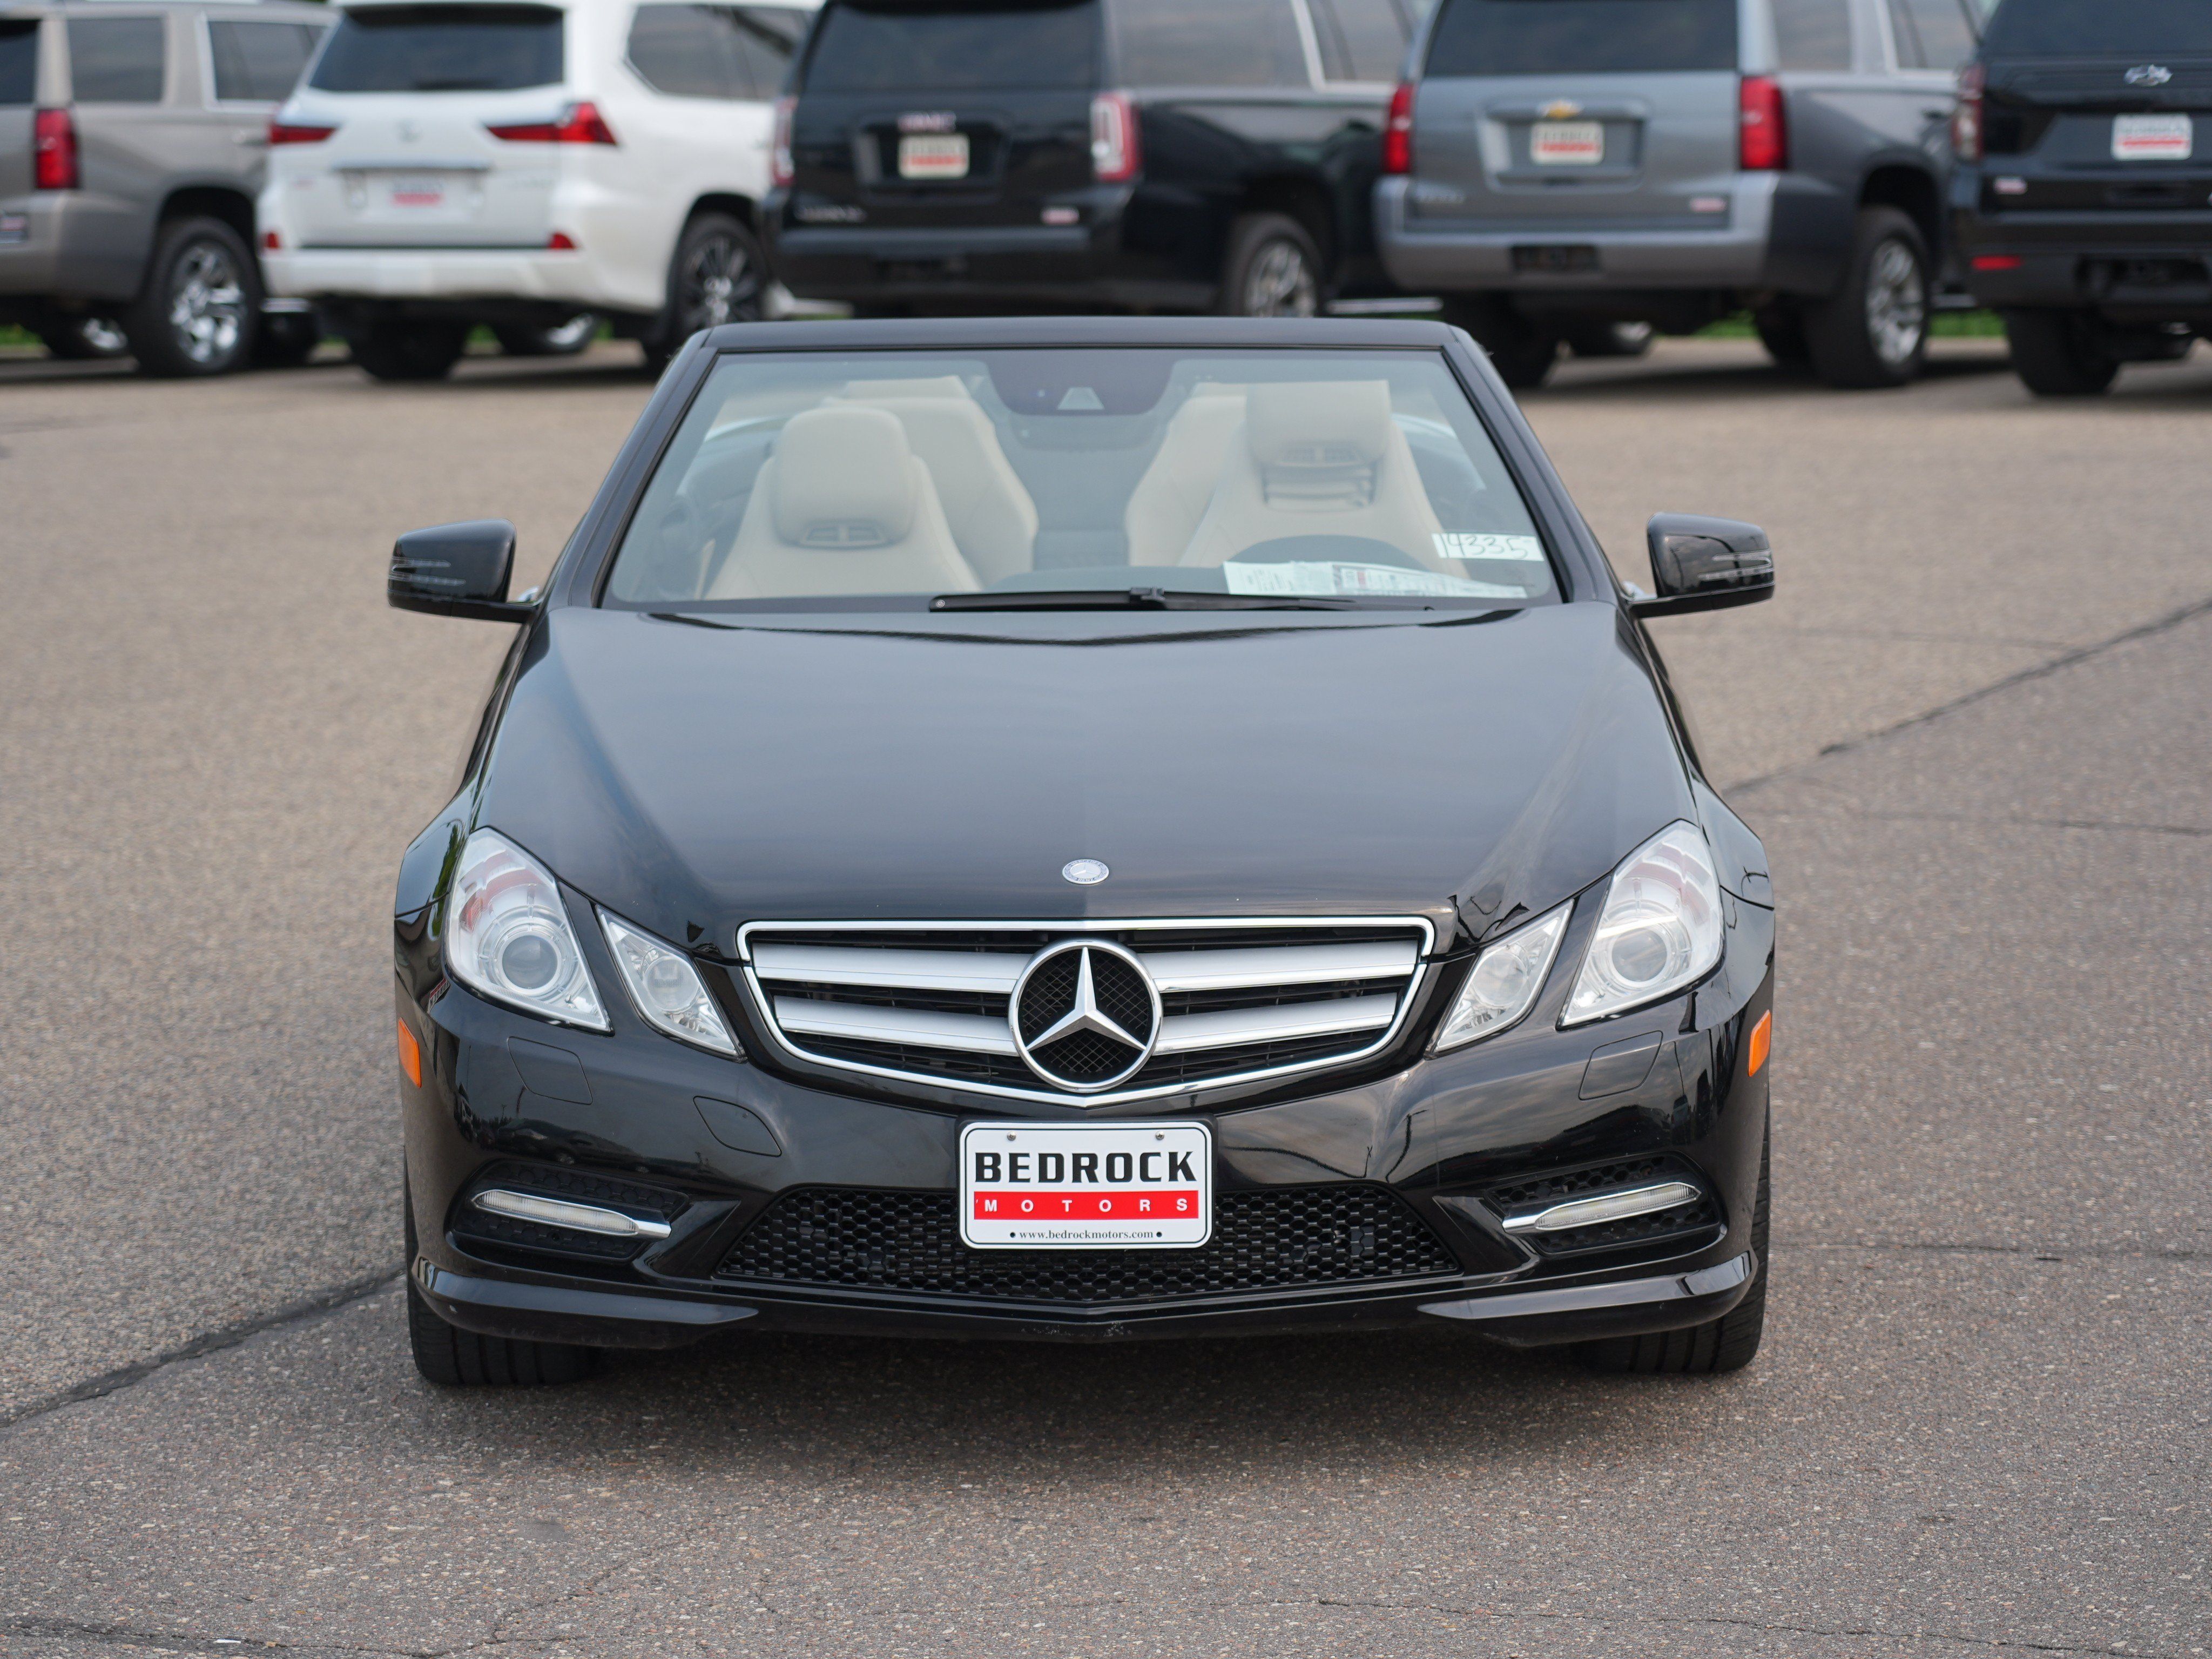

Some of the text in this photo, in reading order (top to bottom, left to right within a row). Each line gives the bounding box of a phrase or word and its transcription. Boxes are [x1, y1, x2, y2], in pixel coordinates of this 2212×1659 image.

[1439, 532, 1528, 559] 14335
[975, 1151, 1197, 1183] BEDROCK
[984, 1198, 1188, 1213] MOTORS
[1019, 1229, 1154, 1239] www.bedrockmotors.com
